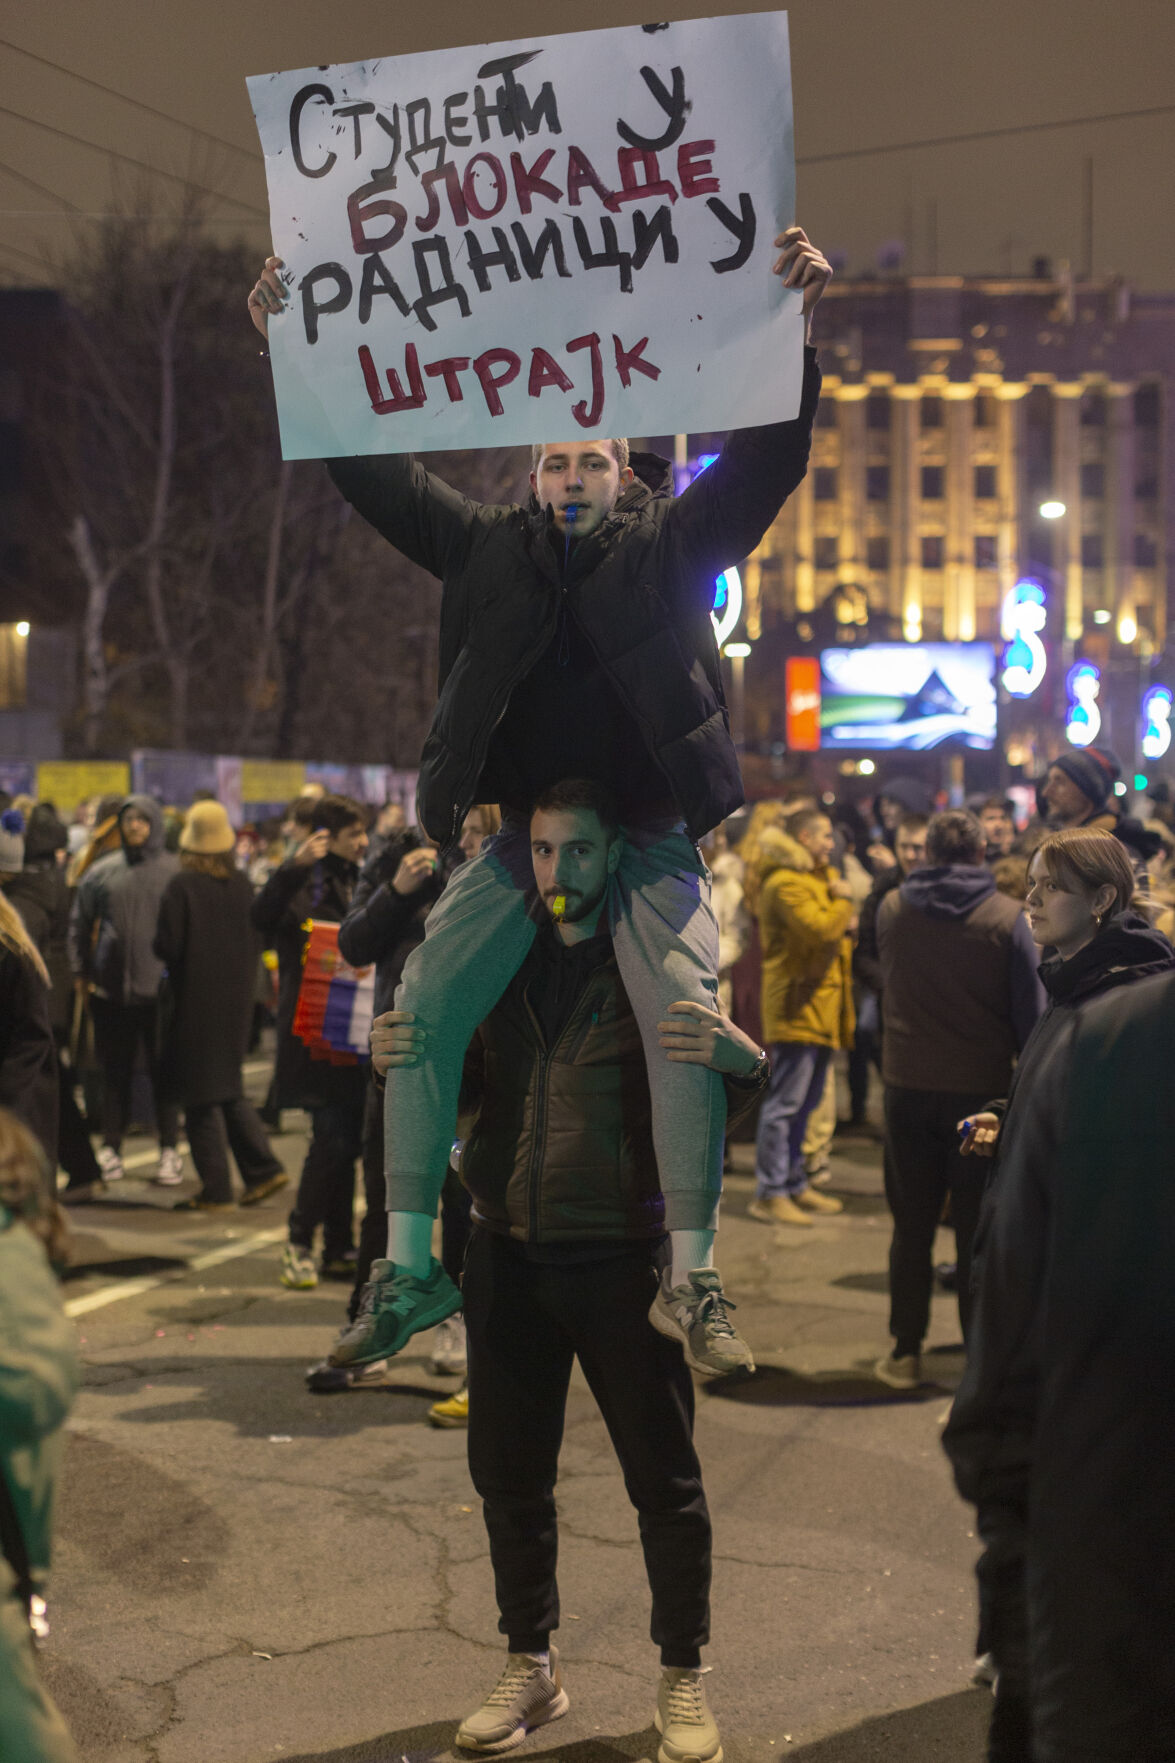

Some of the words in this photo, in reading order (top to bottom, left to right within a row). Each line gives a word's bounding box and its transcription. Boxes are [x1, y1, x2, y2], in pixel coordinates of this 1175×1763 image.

[616, 65, 687, 151] У
[347, 139, 721, 254] БЛОКАДЕ
[298, 205, 680, 345] РАДНИЦИ
[706, 192, 757, 274] У
[358, 332, 662, 428] ШТРАЈК
